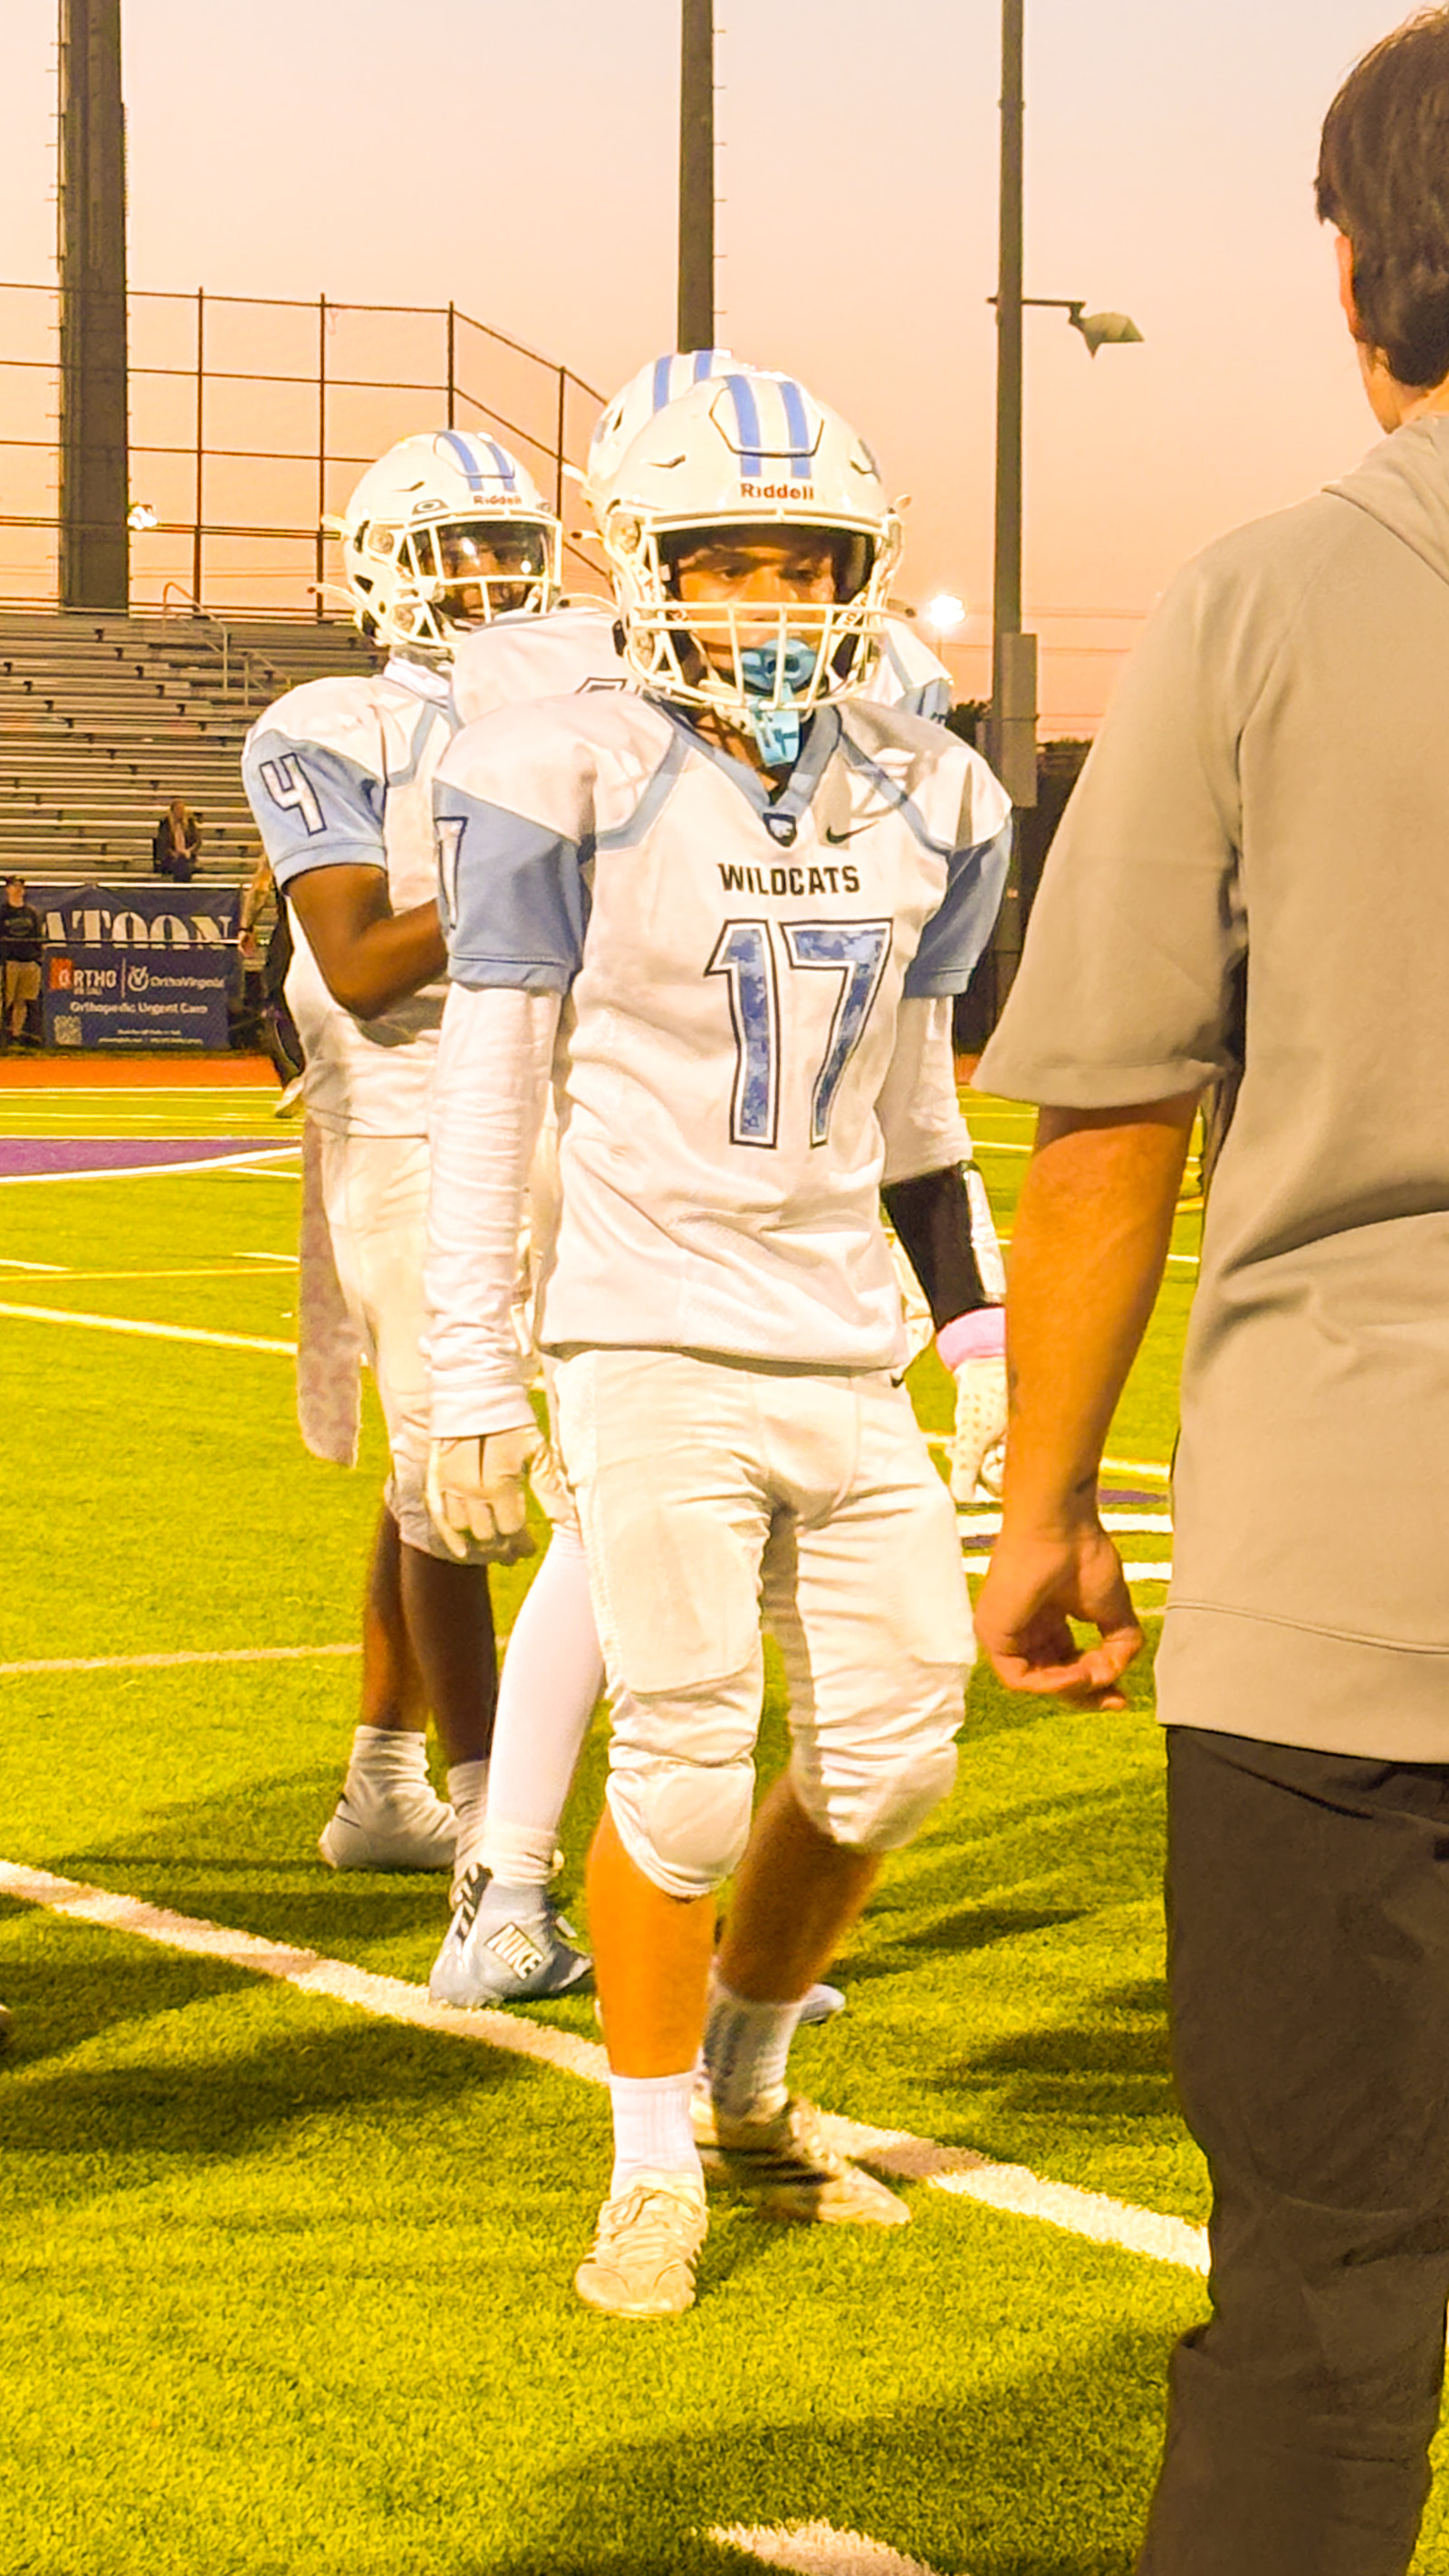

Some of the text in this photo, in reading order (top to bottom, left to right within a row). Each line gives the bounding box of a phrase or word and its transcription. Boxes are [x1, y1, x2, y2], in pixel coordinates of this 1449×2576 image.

[740, 482, 814, 501] Riddell
[259, 752, 327, 837] 4
[718, 863, 860, 895] WILDCATS
[58, 968, 118, 989] ORTHO
[703, 917, 893, 1149] 17
[485, 1923, 544, 1981] NIKE
